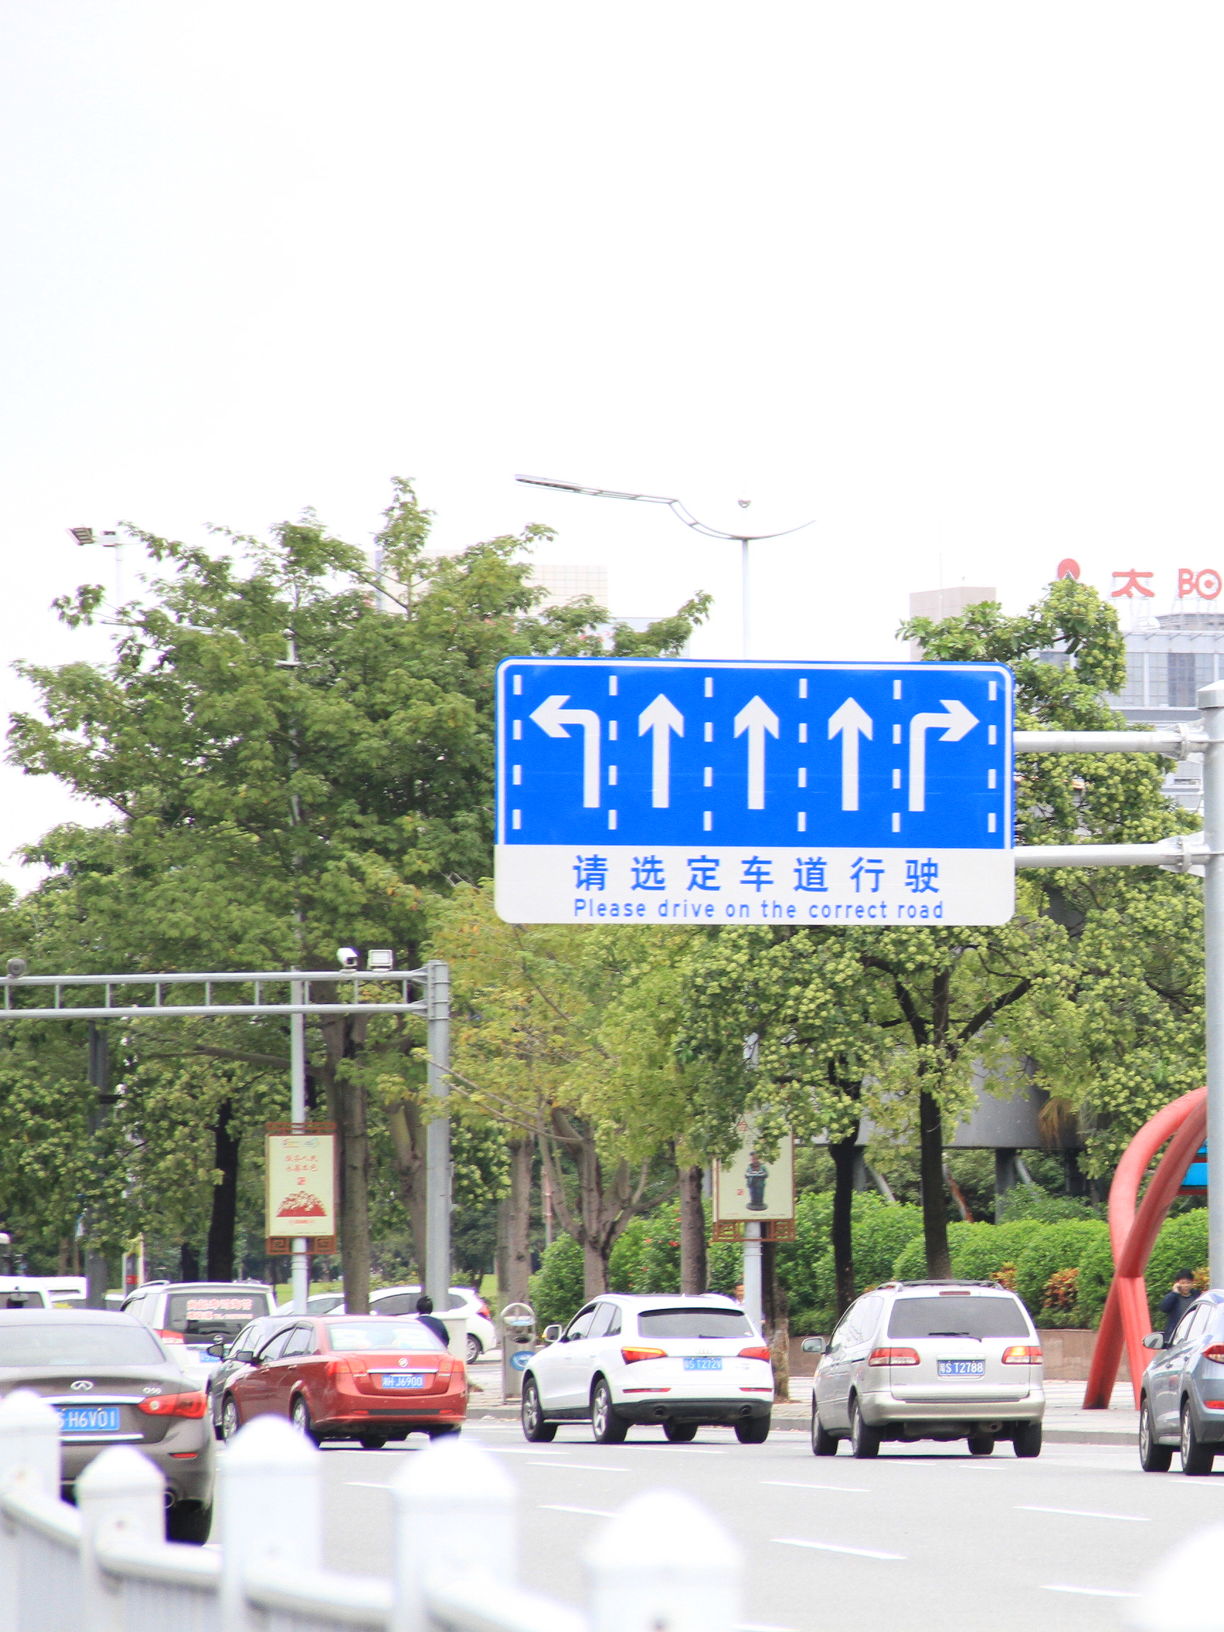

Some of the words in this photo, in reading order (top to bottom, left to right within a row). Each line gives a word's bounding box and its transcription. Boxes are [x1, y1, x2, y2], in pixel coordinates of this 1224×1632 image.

[573, 854, 940, 894] 请选定车道行驶
[574, 899, 646, 917] Please
[658, 899, 715, 918] drive
[726, 903, 750, 918] on
[760, 900, 797, 918] the
[809, 901, 887, 919] correct
[898, 900, 944, 919] road
